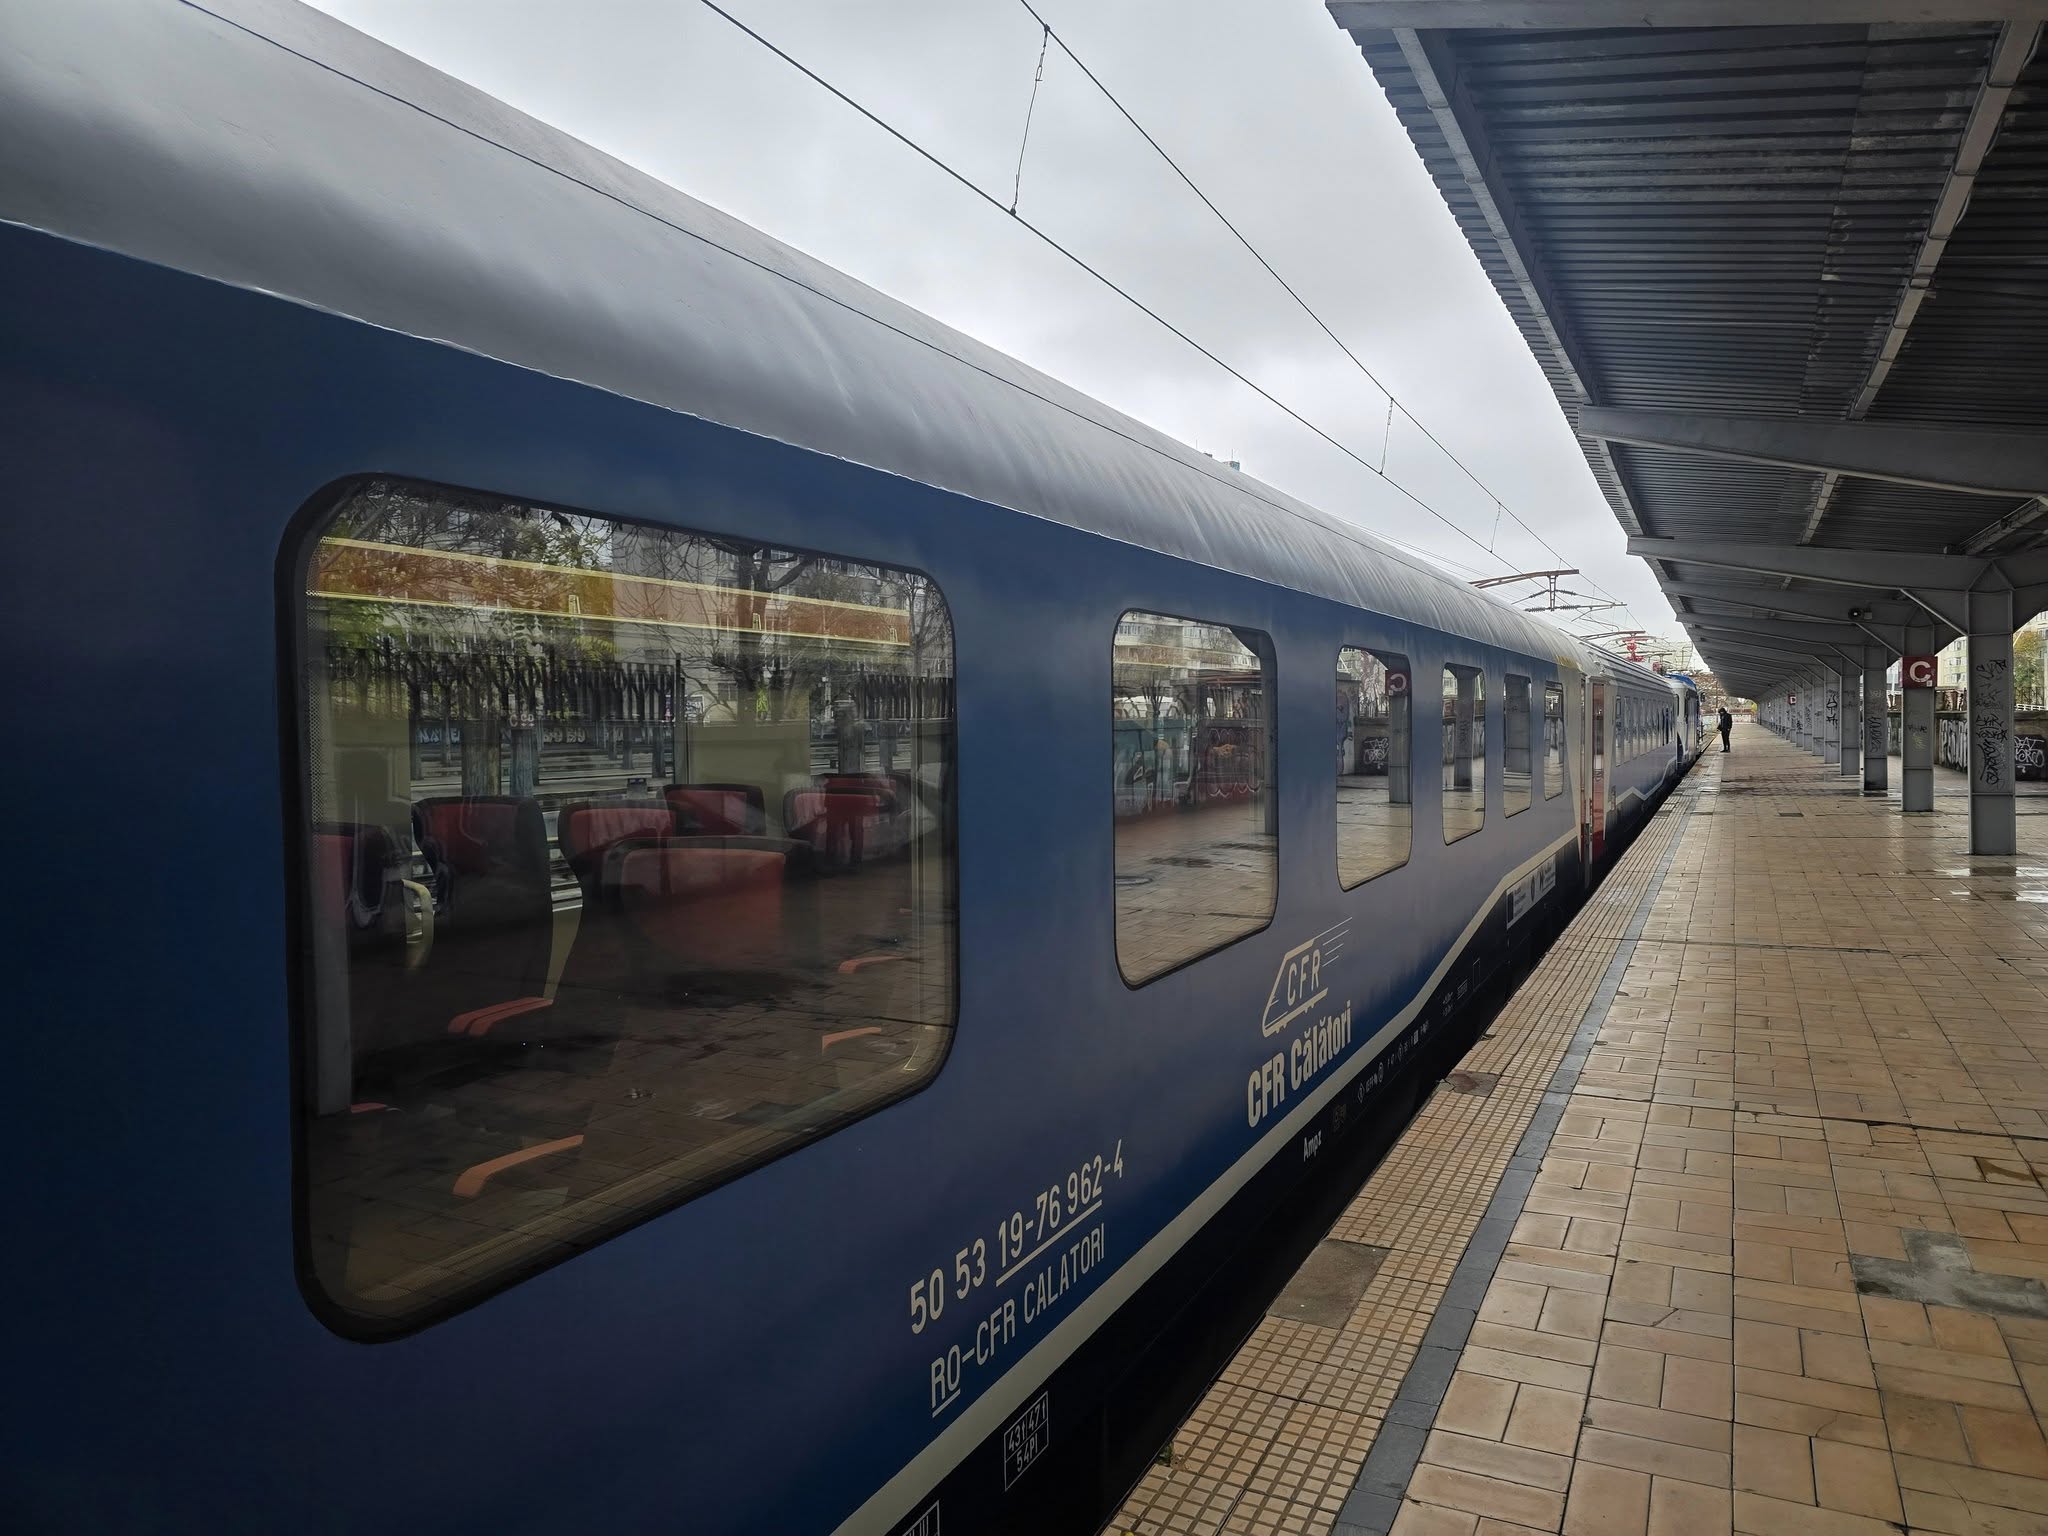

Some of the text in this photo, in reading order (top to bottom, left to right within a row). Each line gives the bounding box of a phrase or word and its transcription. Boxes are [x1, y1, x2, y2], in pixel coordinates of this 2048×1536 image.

[1909, 660, 1932, 683] C
[1287, 949, 1321, 1006] CFR
[1247, 999, 1352, 1128] CFR Călători
[910, 1138, 1124, 1335] 50 53 19-76 962-4
[930, 1222, 1106, 1410] RO-CFR CALATORI
